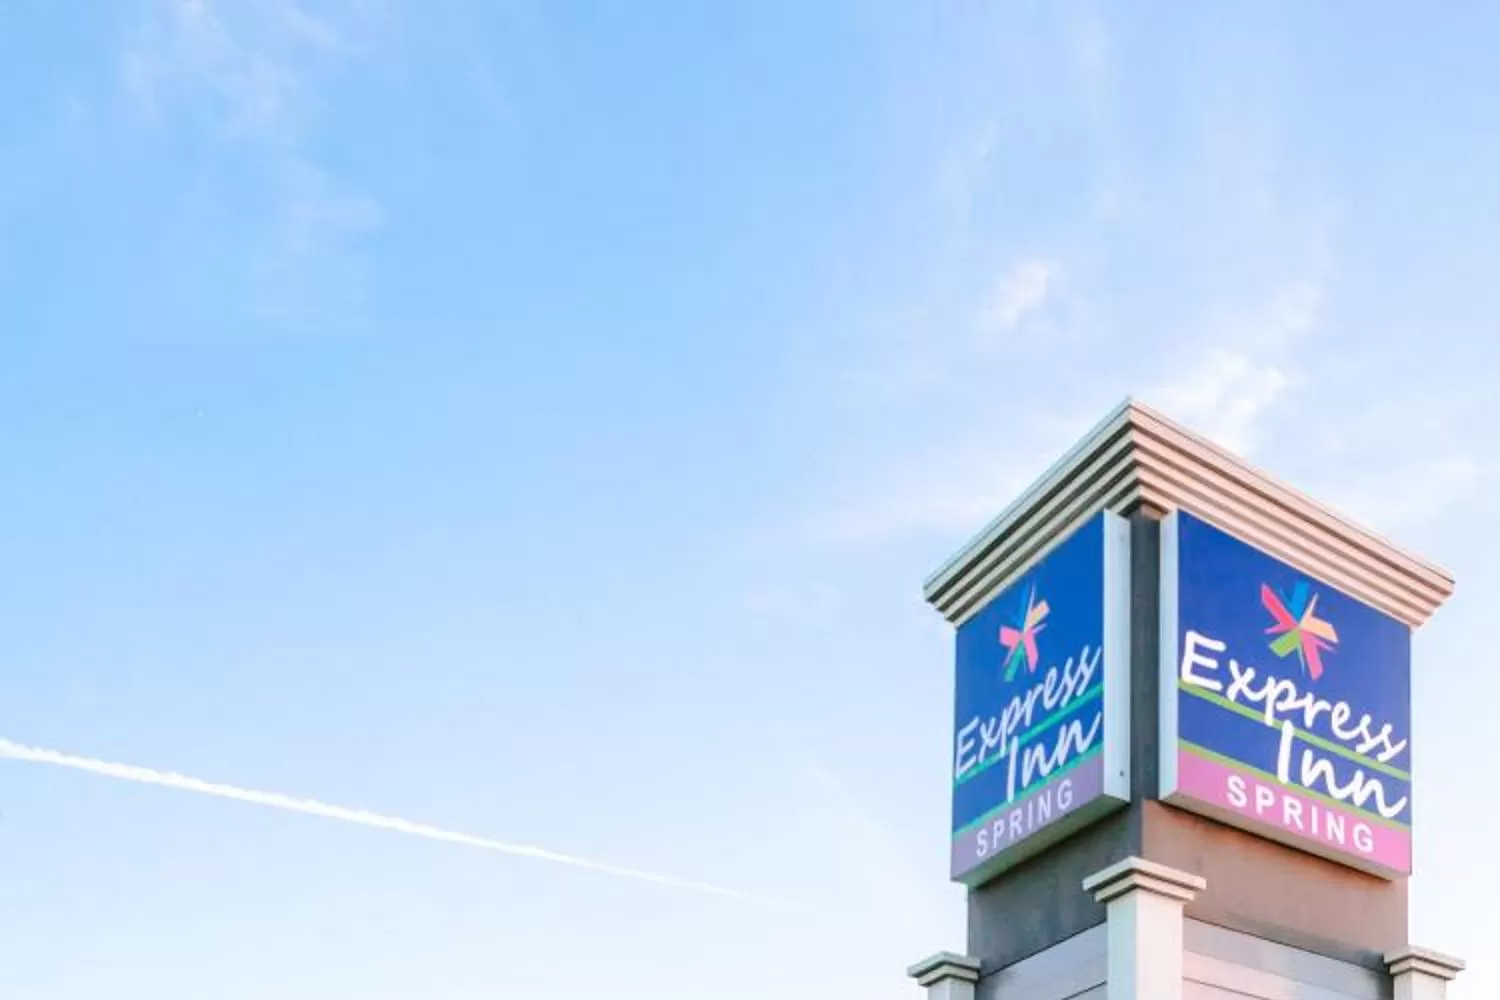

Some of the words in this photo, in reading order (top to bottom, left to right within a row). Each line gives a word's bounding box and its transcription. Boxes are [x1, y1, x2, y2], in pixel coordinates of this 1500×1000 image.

[956, 646, 1101, 779] Express
[1181, 630, 1407, 761] Express
[1005, 711, 1101, 803] Inn
[1277, 720, 1407, 818] Inn
[976, 779, 1073, 857] SPRING
[1227, 775, 1374, 854] SPRING
